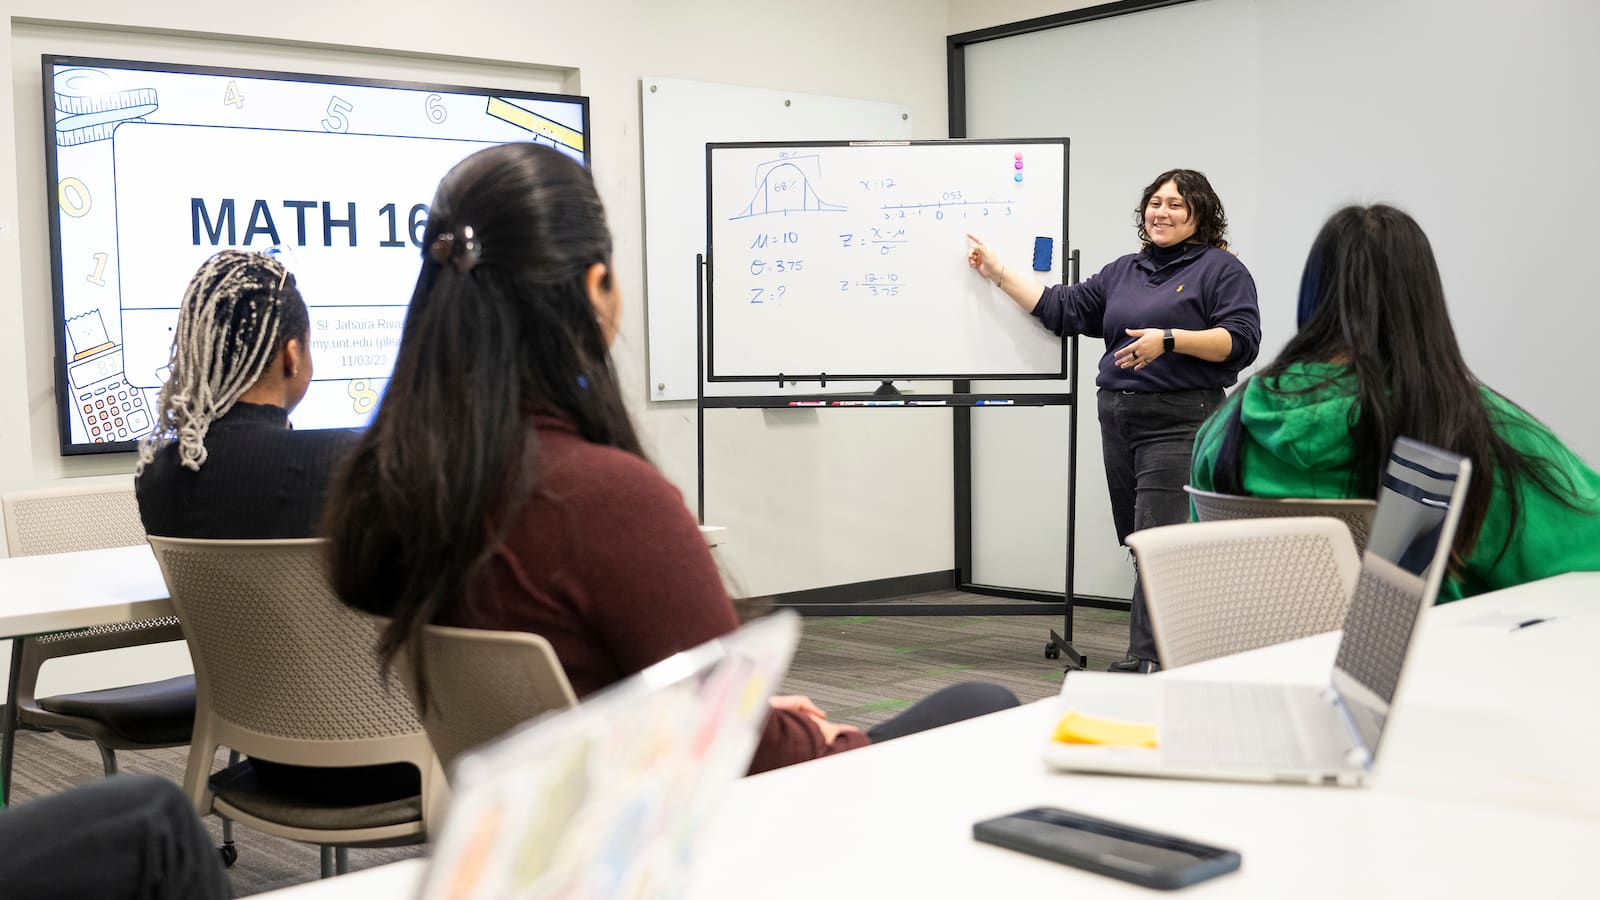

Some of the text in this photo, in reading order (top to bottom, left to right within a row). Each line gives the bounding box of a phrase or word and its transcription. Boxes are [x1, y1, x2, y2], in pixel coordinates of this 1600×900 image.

[224, 80, 245, 109] 4
[425, 94, 448, 124] 6
[321, 95, 353, 134] 5
[190, 197, 430, 248] MATH 16
[86, 252, 109, 287] 1
[335, 319, 375, 331] Jahaira
[341, 354, 387, 367] 11/03/23
[348, 378, 378, 415] 8
